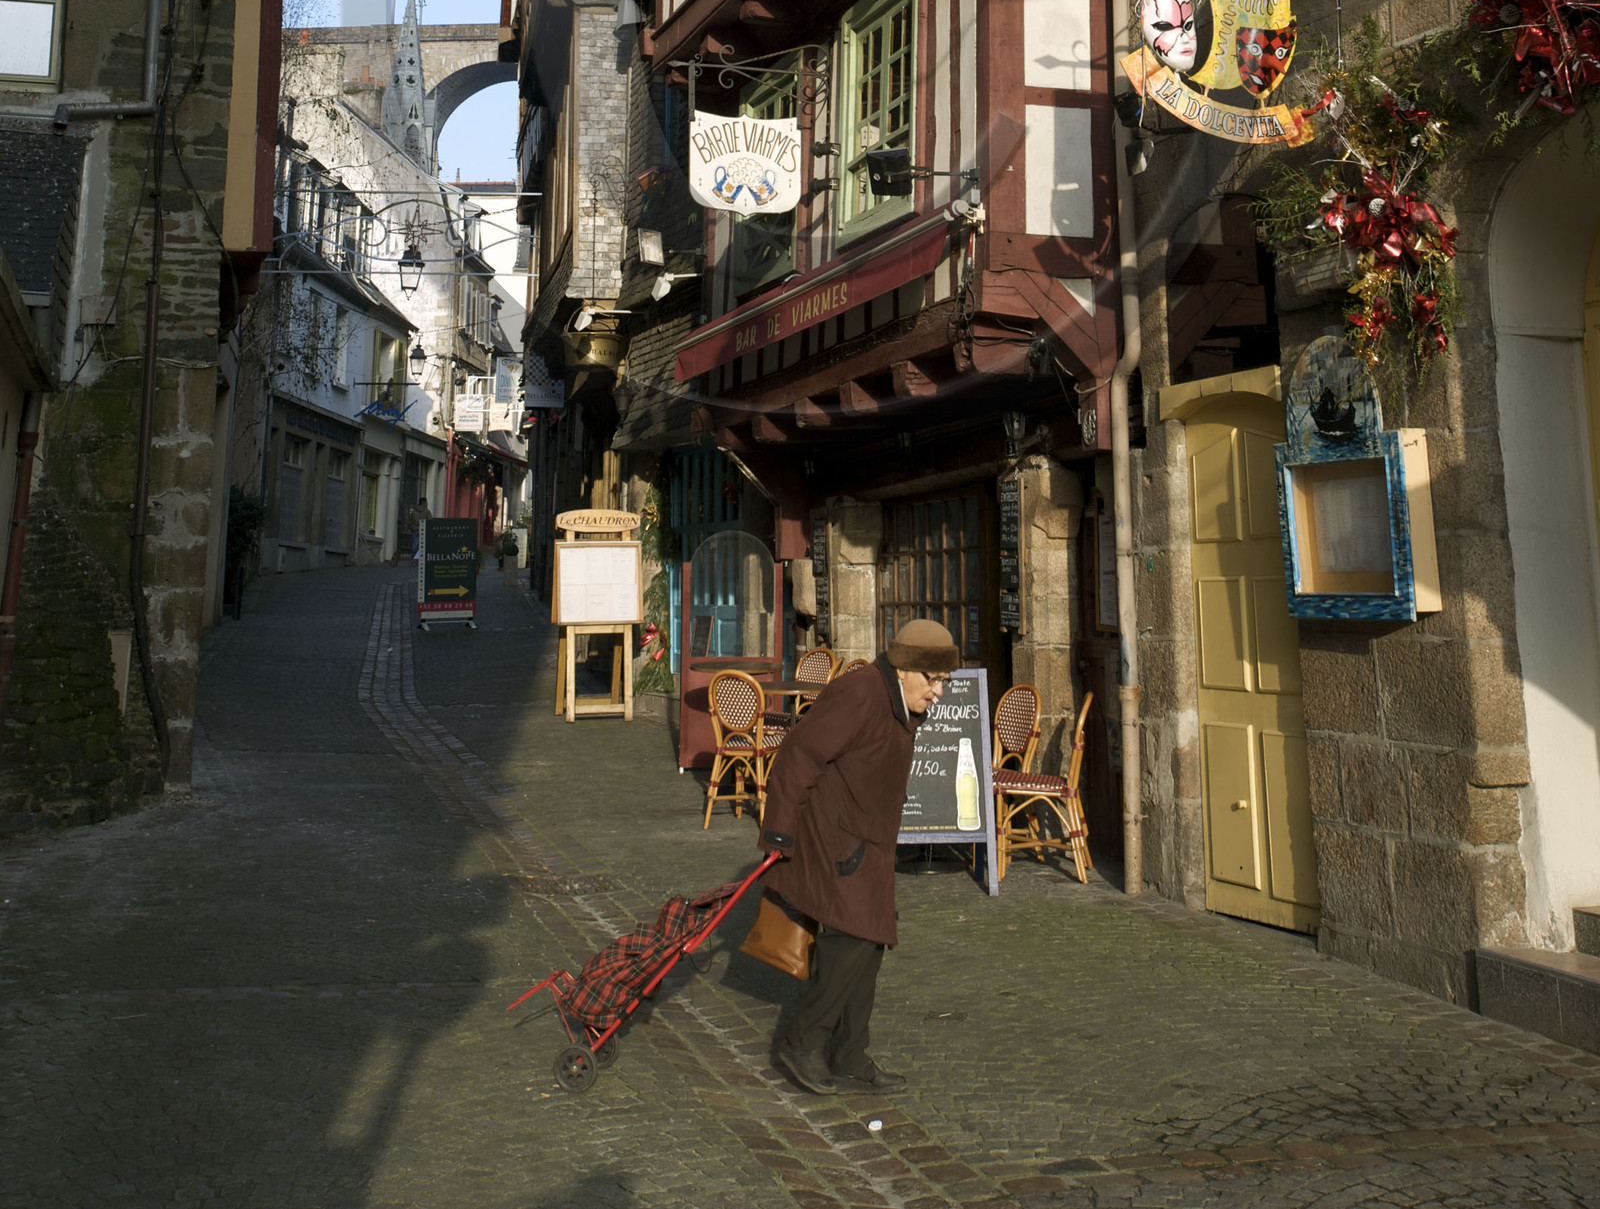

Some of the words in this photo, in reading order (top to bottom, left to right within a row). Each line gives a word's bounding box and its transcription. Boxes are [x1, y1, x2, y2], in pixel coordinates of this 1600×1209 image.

[1155, 78, 1181, 109] LA
[735, 327, 757, 352] BAR
[767, 312, 782, 339] DE
[791, 281, 849, 327] VIARMES
[573, 515, 639, 526] CHAUDRON
